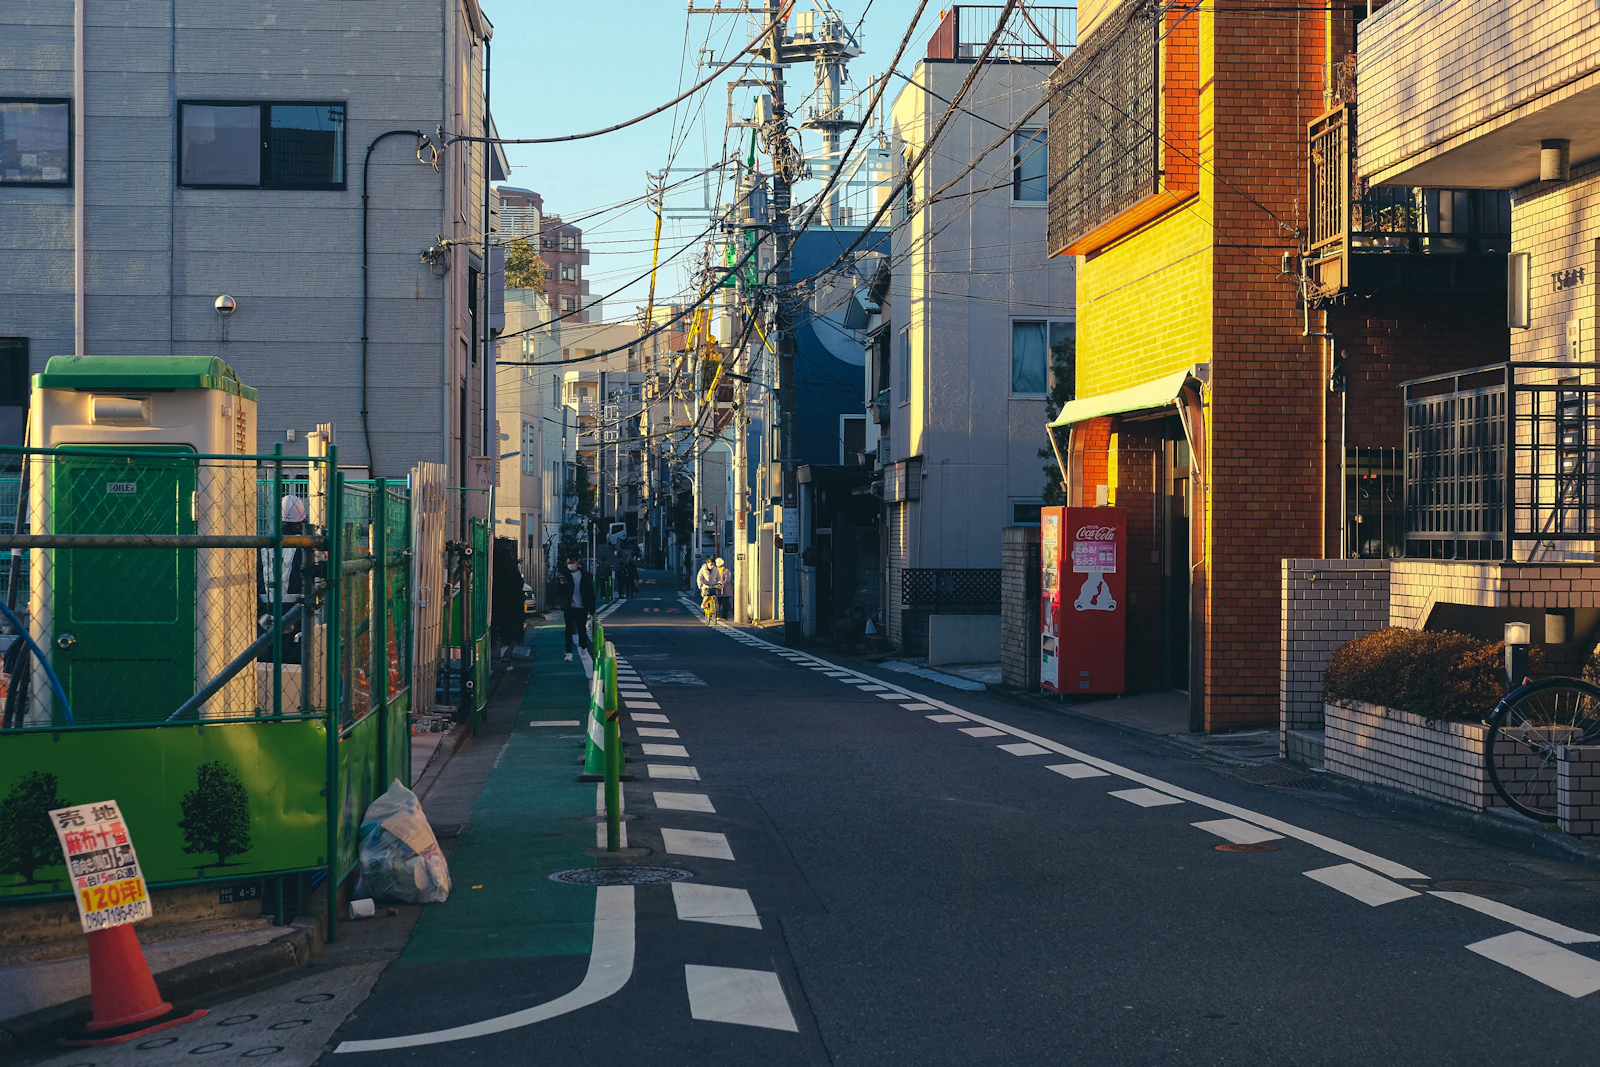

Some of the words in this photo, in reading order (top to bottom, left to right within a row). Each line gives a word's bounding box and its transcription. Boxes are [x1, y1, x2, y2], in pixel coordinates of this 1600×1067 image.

[1076, 526, 1116, 540] Coca-Cola
[64, 821, 128, 854] 麻布十番
[239, 887, 256, 897] 4-9
